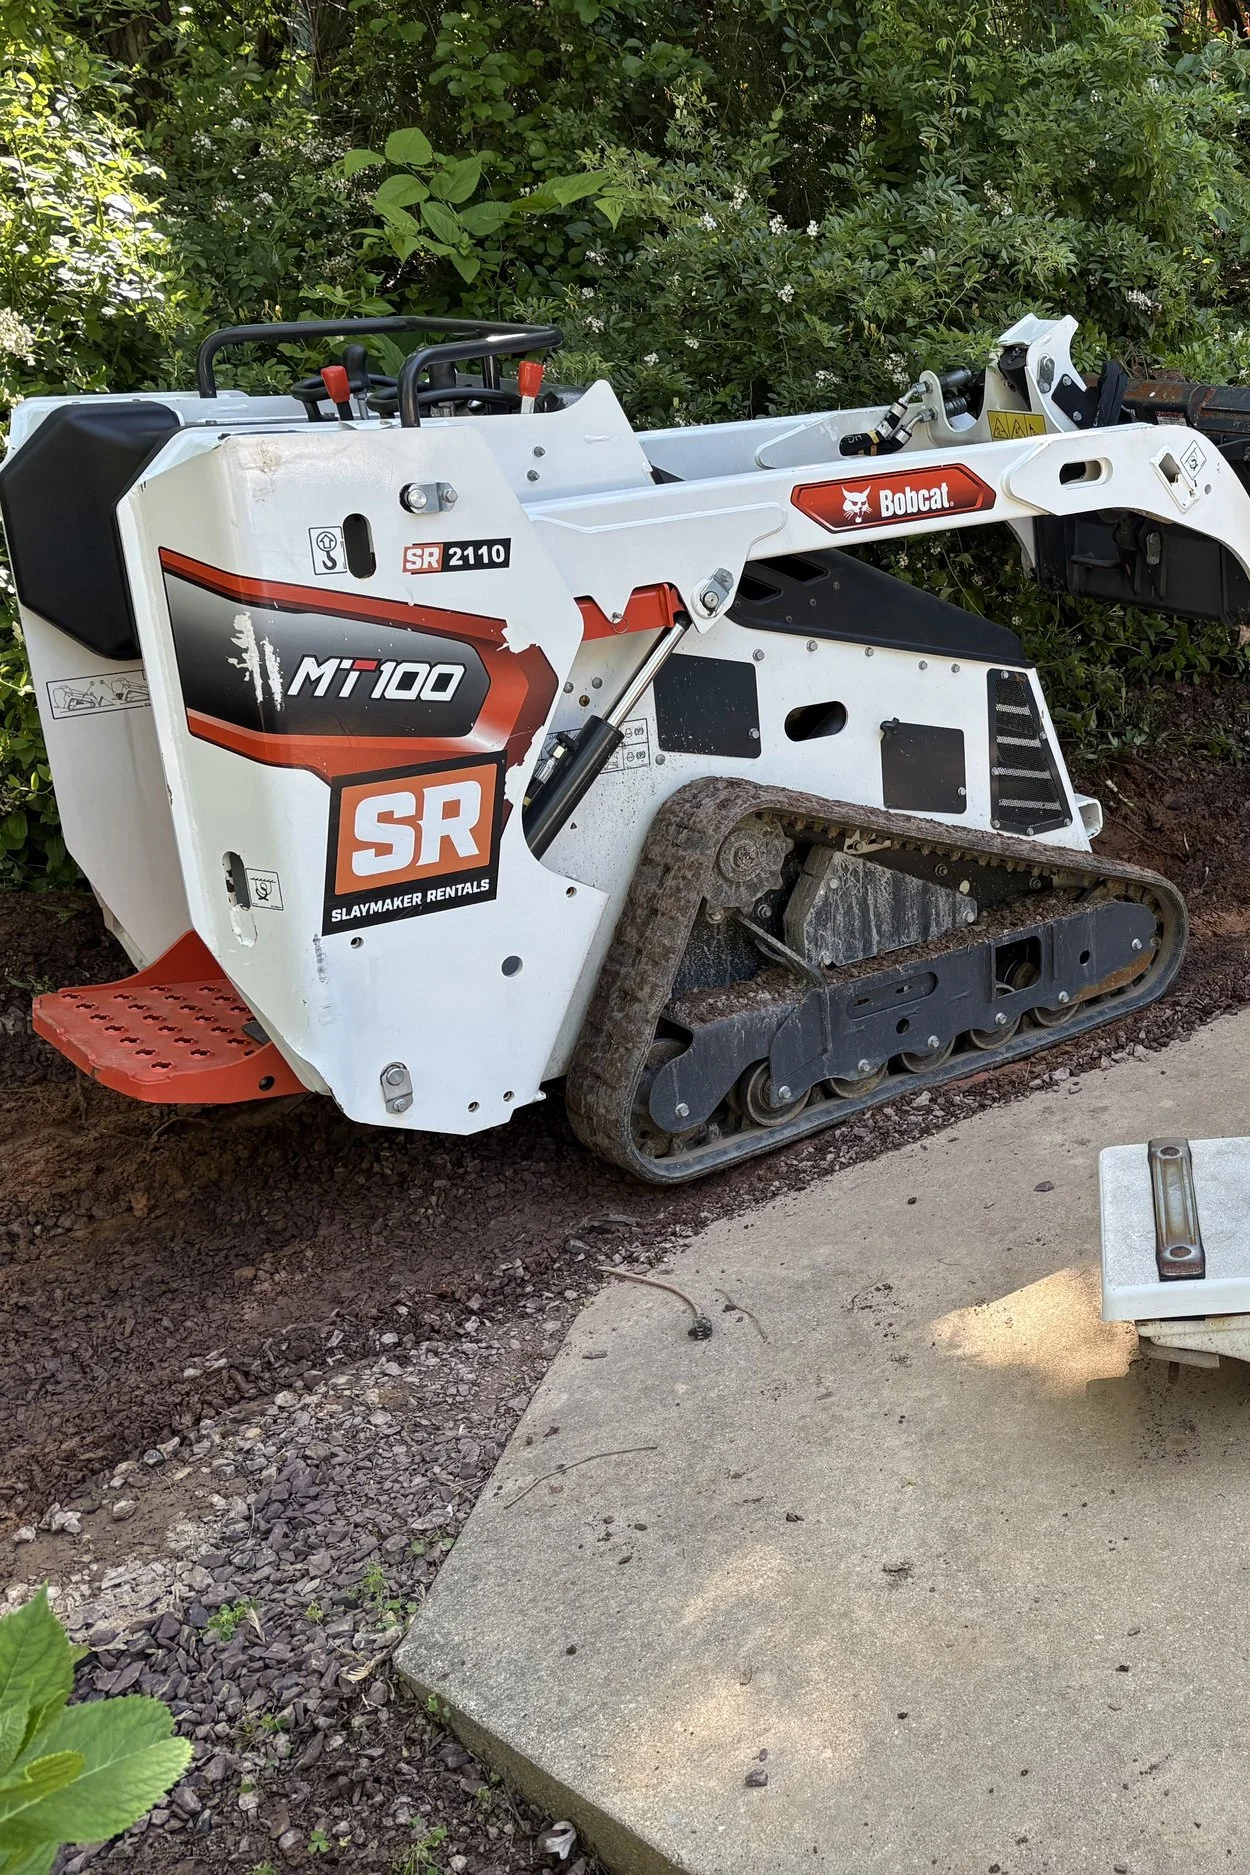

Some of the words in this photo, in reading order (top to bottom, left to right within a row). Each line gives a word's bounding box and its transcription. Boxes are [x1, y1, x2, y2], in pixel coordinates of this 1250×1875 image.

[880, 482, 950, 518] Bobcat
[405, 547, 440, 570] SR
[448, 544, 505, 566] 2110
[287, 656, 466, 701] MT100
[352, 780, 482, 877] SR
[331, 892, 422, 922] SLAYMAKER
[427, 878, 490, 903] RENTALS
